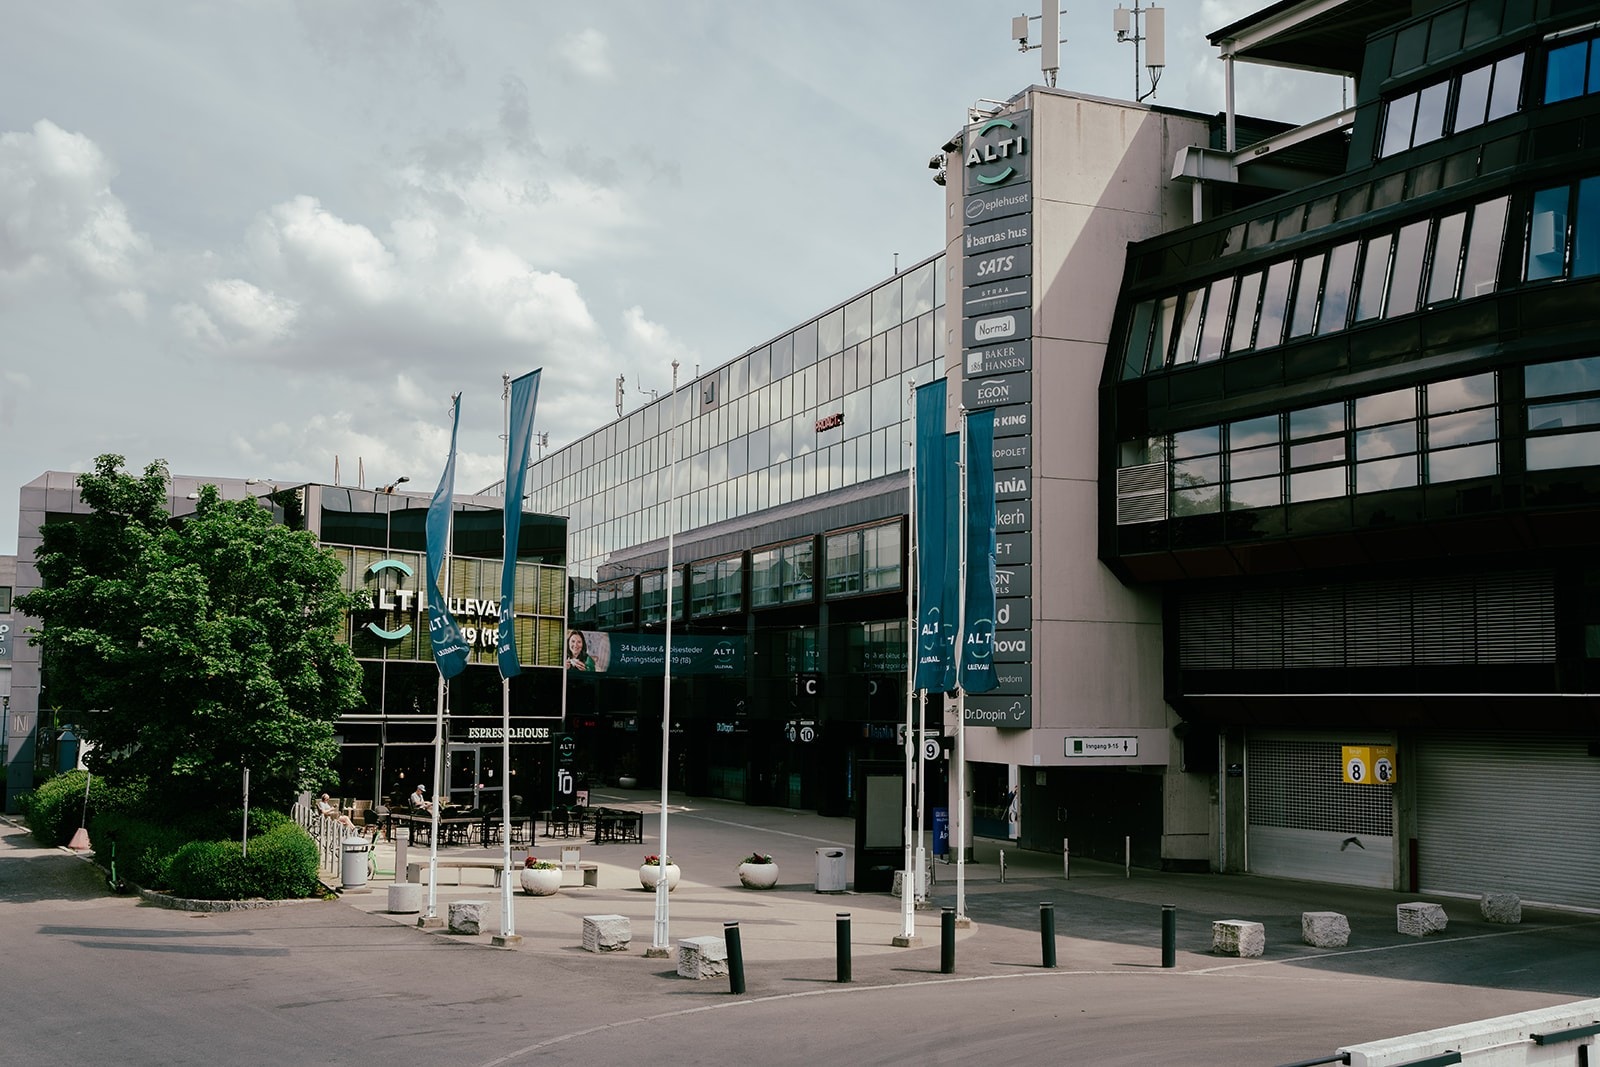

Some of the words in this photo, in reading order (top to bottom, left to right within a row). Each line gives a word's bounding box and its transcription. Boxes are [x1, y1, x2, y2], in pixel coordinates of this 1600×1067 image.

[965, 136, 1023, 167] ALTI
[985, 194, 1028, 210] eplehuset
[973, 232, 1006, 247] barnas
[1008, 228, 1028, 239] hus
[977, 255, 1014, 276] SATS
[979, 320, 1011, 336] Normal
[985, 347, 1015, 359] BAKER
[985, 357, 1025, 371] HANSEN
[977, 385, 1009, 399] EGON
[1001, 415, 1027, 426] KING
[992, 447, 1027, 458] OPOLET
[967, 633, 992, 644] ALT
[620, 644, 630, 652] 34
[630, 645, 658, 653] butikker
[713, 648, 735, 656] ALTI
[999, 675, 1023, 683] endom
[964, 708, 1007, 722] Dr.Dropin
[468, 727, 516, 739] ESPRESO
[516, 728, 549, 738] HOUSE
[925, 744, 936, 758] 9
[1085, 743, 1107, 751] Inngang
[1352, 764, 1361, 780] 8
[1379, 764, 1388, 780] 8
